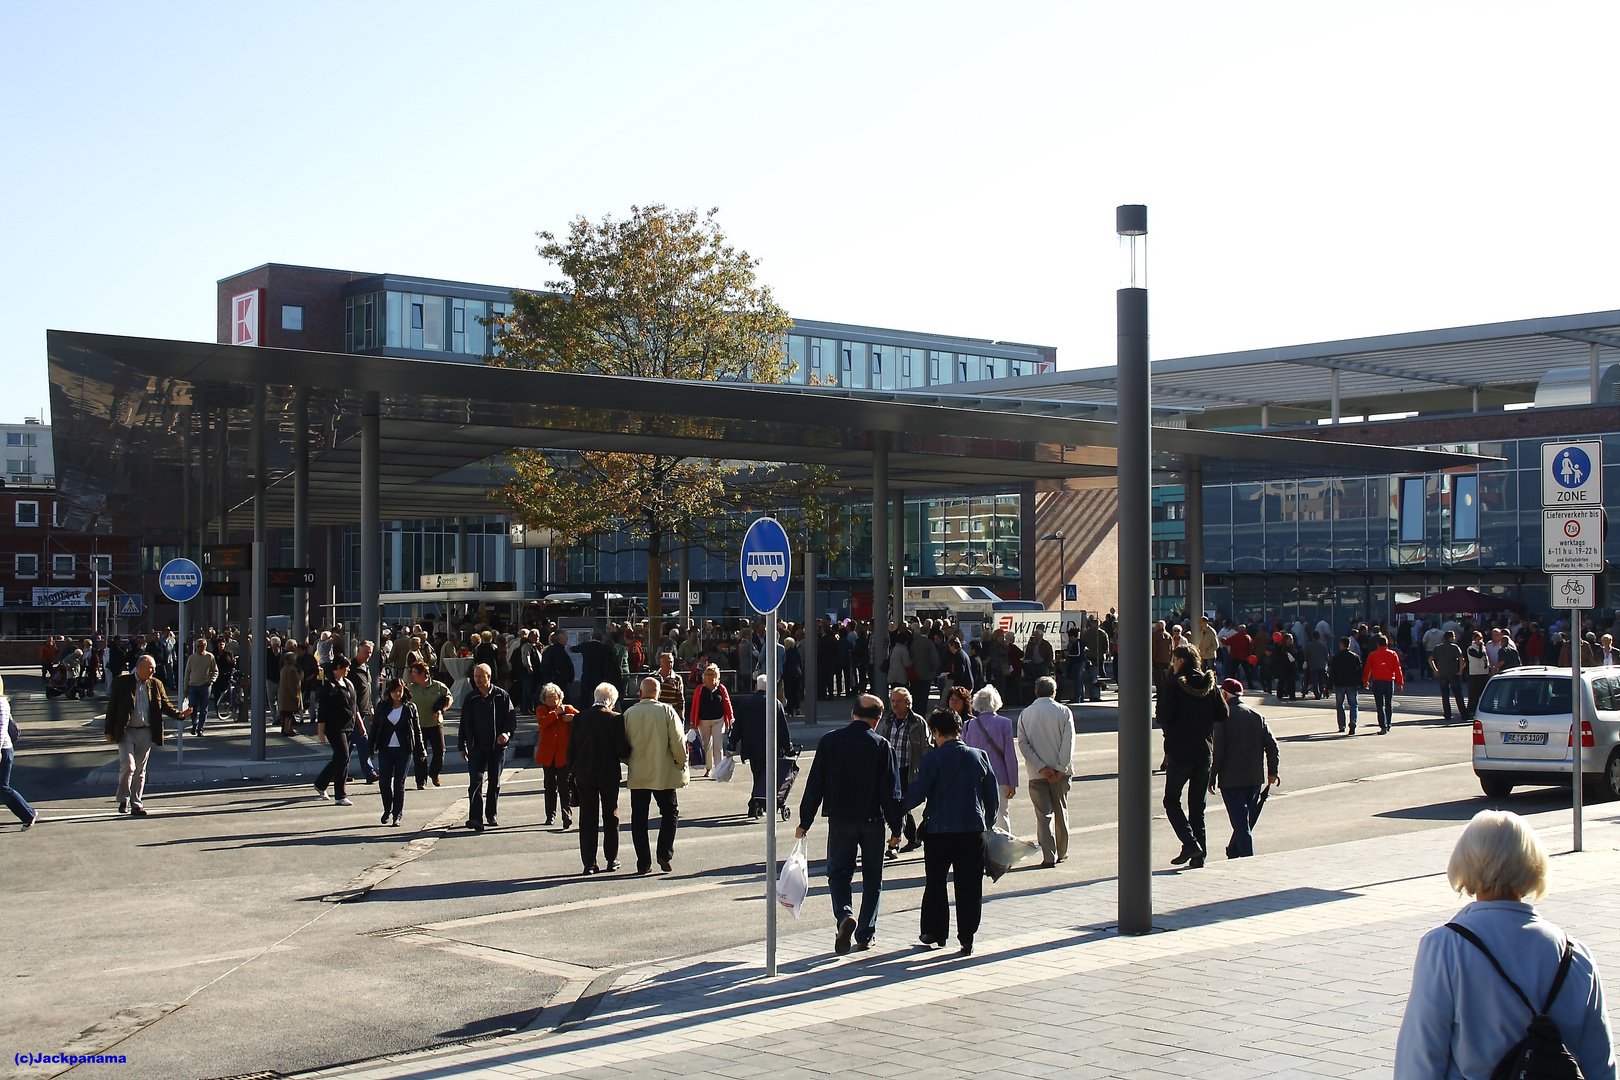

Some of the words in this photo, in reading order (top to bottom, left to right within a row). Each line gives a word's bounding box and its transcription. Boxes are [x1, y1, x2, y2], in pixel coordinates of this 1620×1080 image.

[1557, 491, 1587, 501] ZONE
[1546, 511, 1587, 519] Lieferverkehr
[203, 552, 211, 564] 11
[1164, 568, 1168, 576] 6
[304, 574, 314, 582] 10
